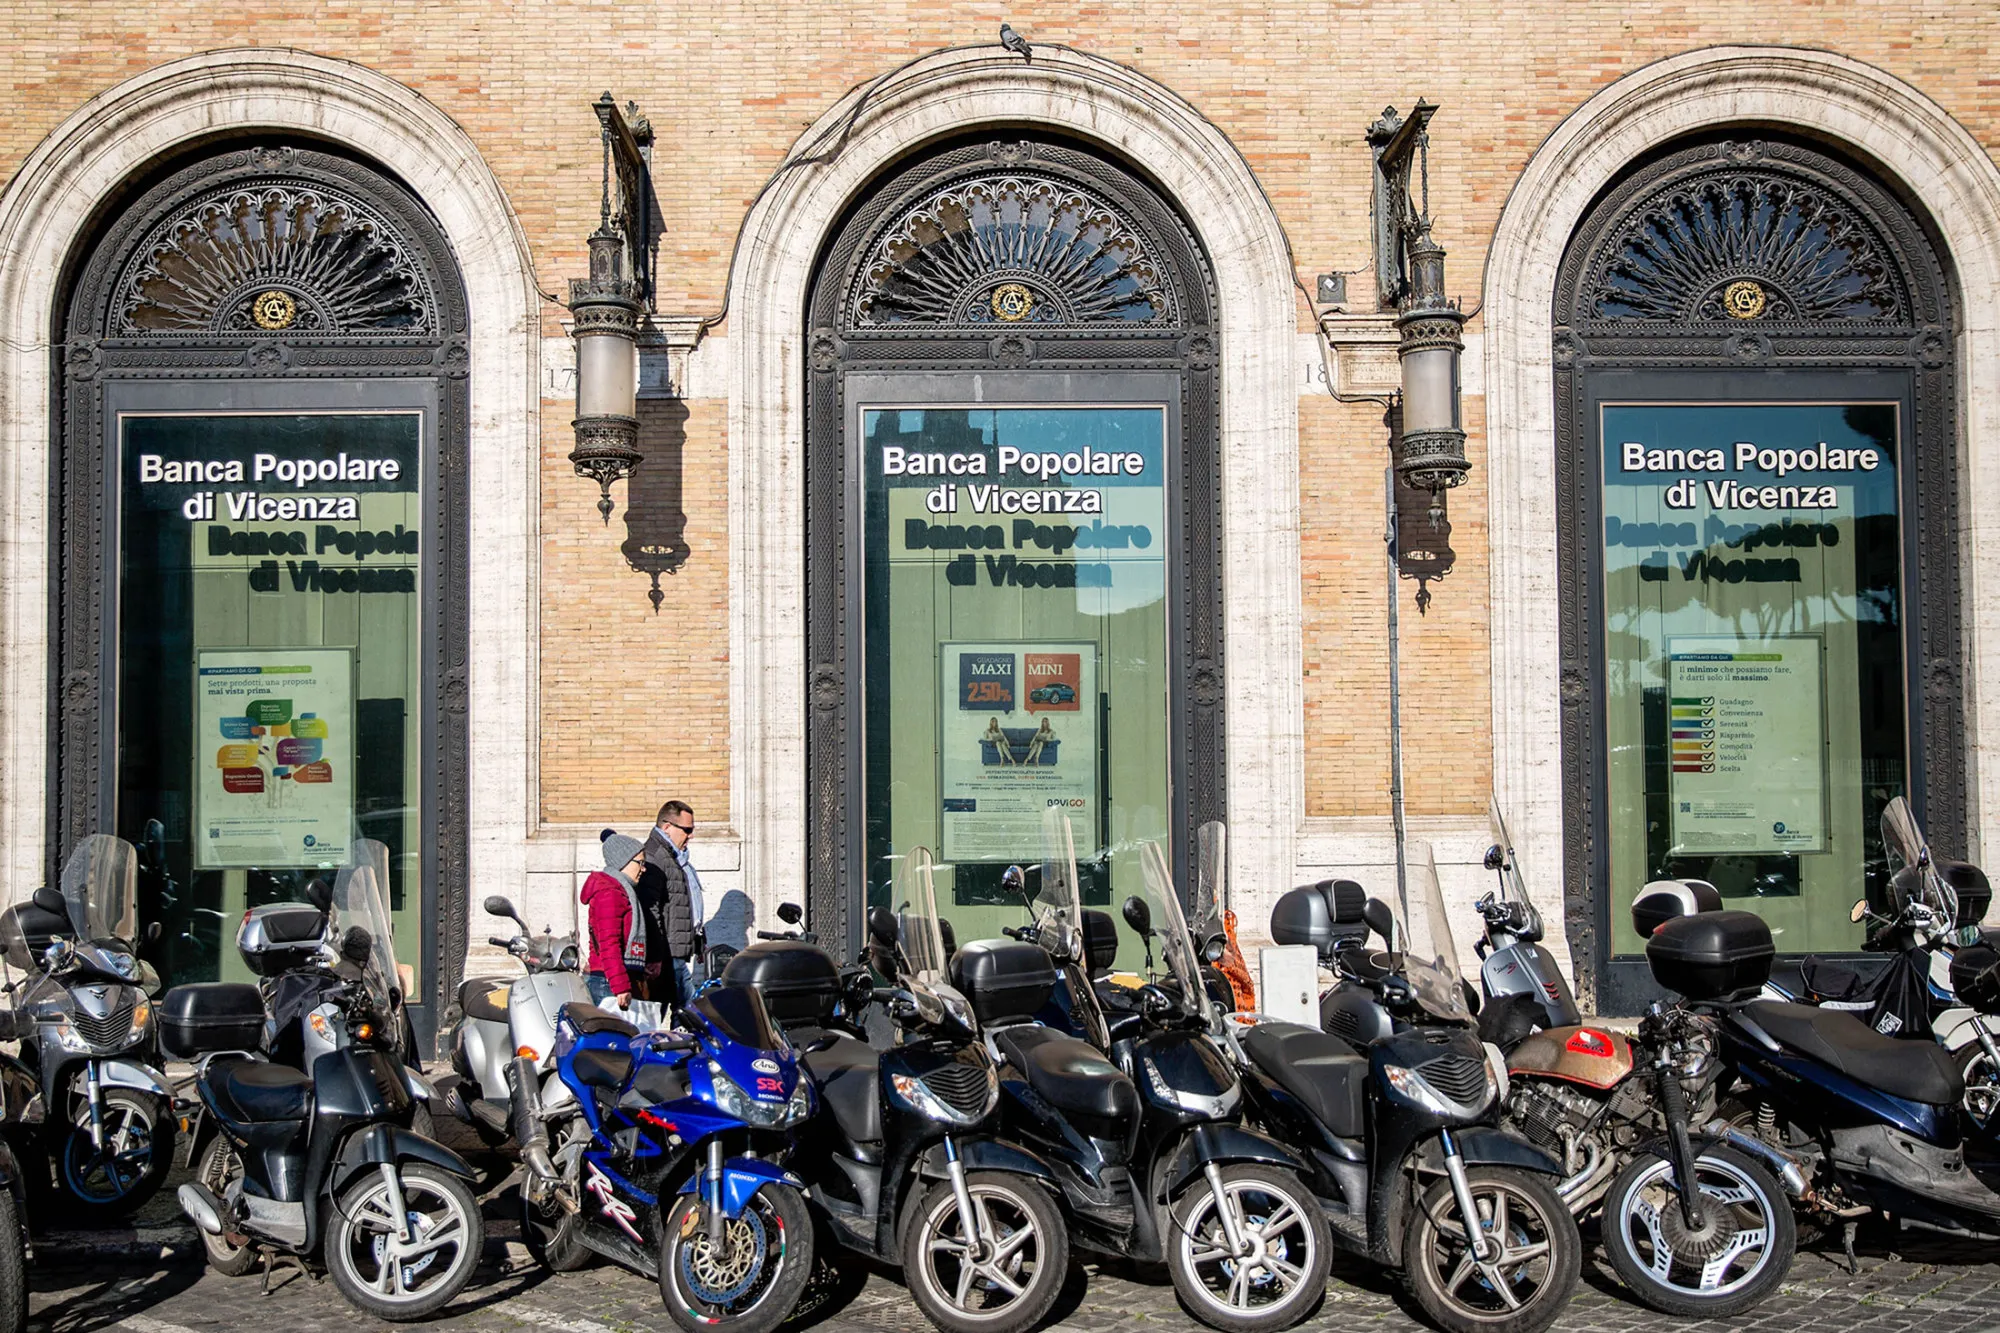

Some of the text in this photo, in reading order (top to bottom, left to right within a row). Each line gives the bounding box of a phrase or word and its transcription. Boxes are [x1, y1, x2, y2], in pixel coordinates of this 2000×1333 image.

[141, 452, 400, 488] Banca Popolare
[882, 445, 1144, 481] Banca Popolare
[1622, 442, 1879, 477] Banca Popolare
[183, 491, 358, 521] di Vicenza
[926, 483, 1103, 513] di Vicenza
[1666, 479, 1838, 509] di Vicenza
[282, 678, 317, 688] proposta
[971, 663, 1012, 675] MAXI
[1028, 663, 1063, 676] MINI
[1736, 666, 1773, 674] possiamo
[207, 687, 224, 695] mai
[225, 687, 245, 695] vista
